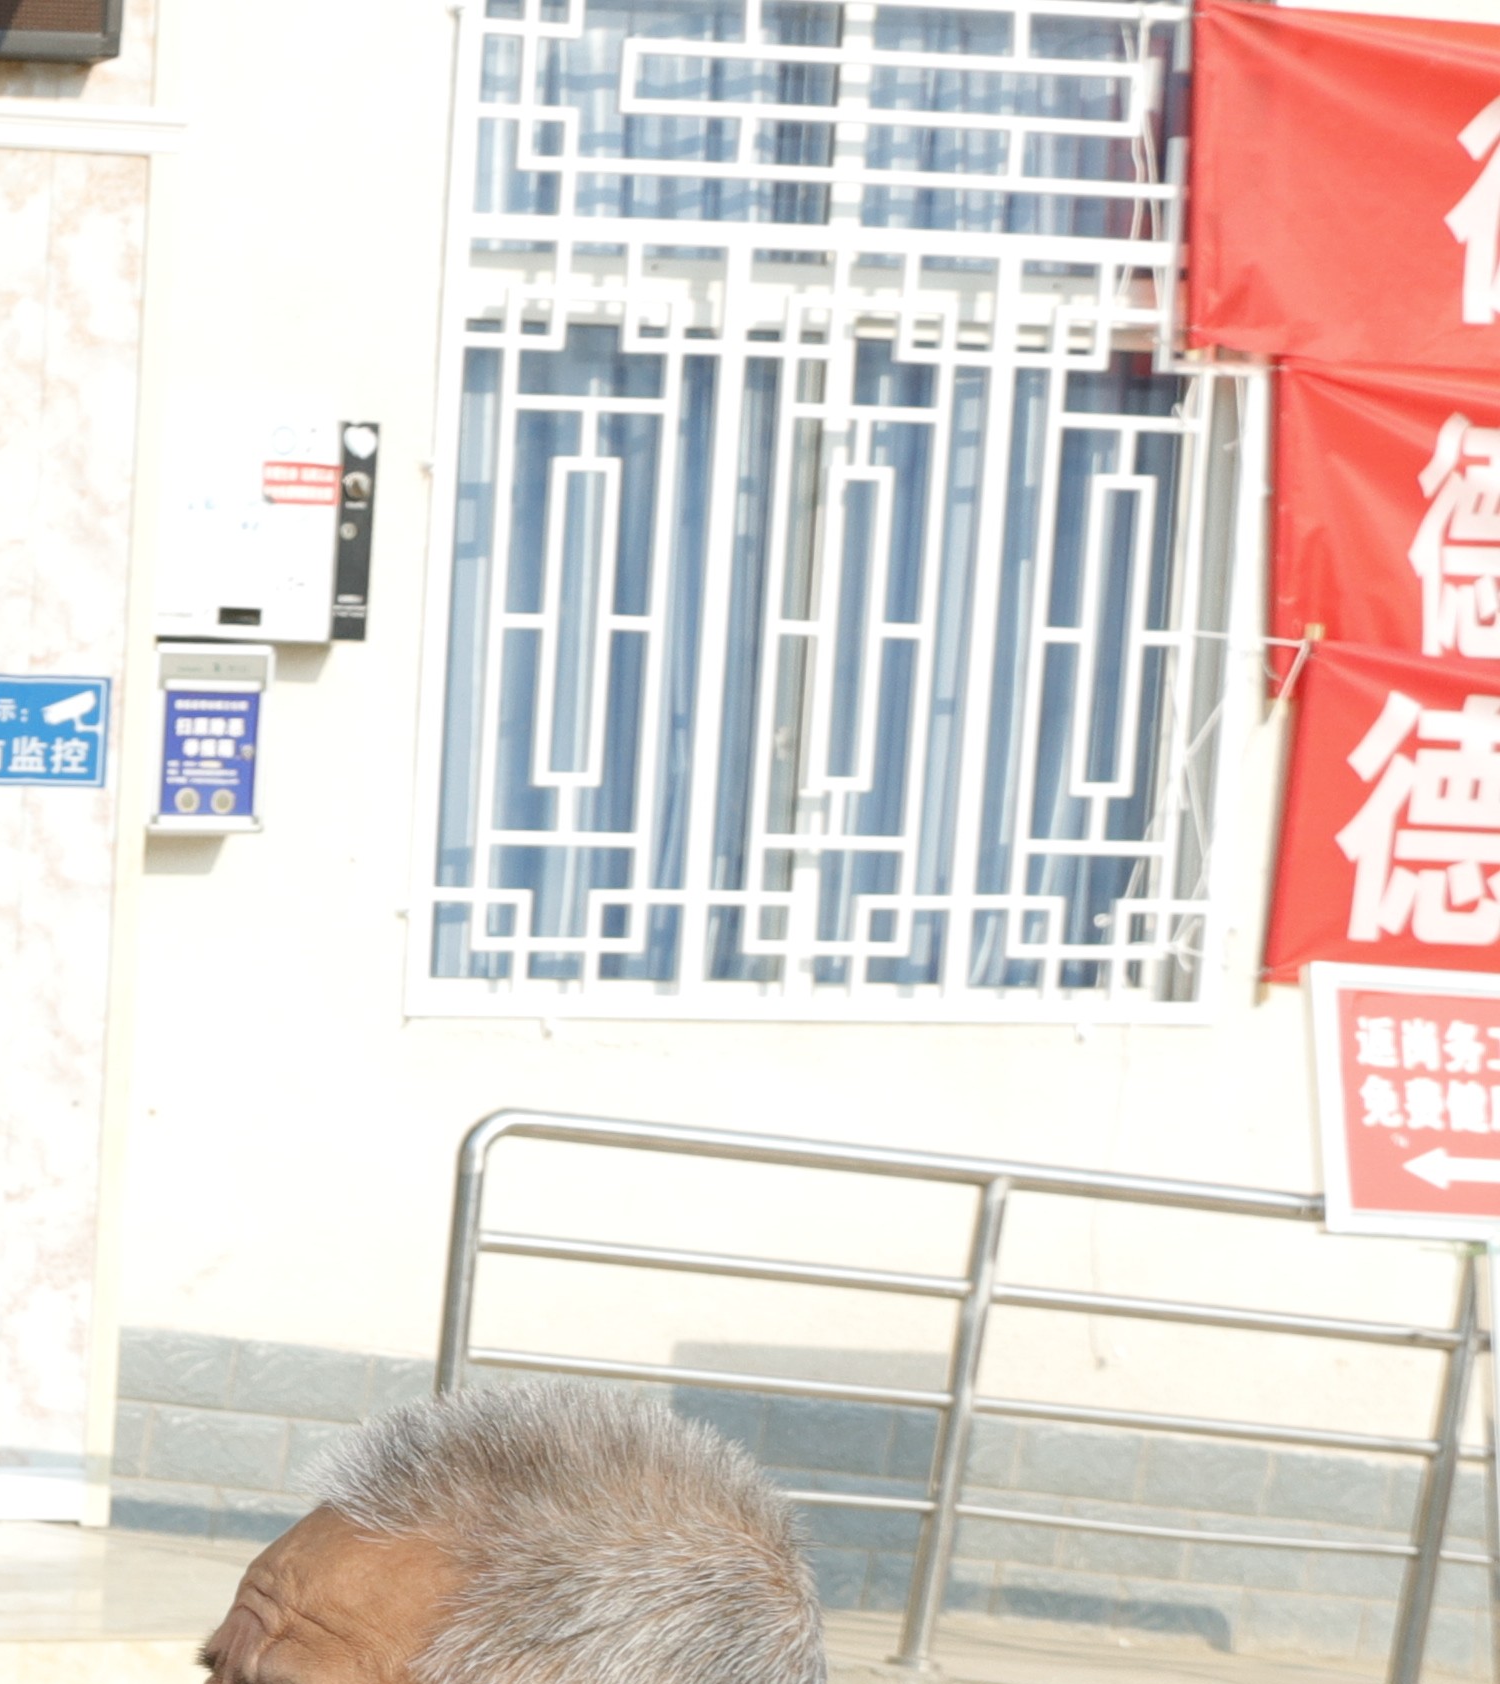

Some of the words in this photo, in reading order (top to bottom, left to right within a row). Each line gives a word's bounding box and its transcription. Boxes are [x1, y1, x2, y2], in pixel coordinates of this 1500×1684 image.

[1334, 689, 1500, 947] 德
[1355, 1015, 1500, 1075] 返岗务
[1359, 1073, 1500, 1134] 免费健
